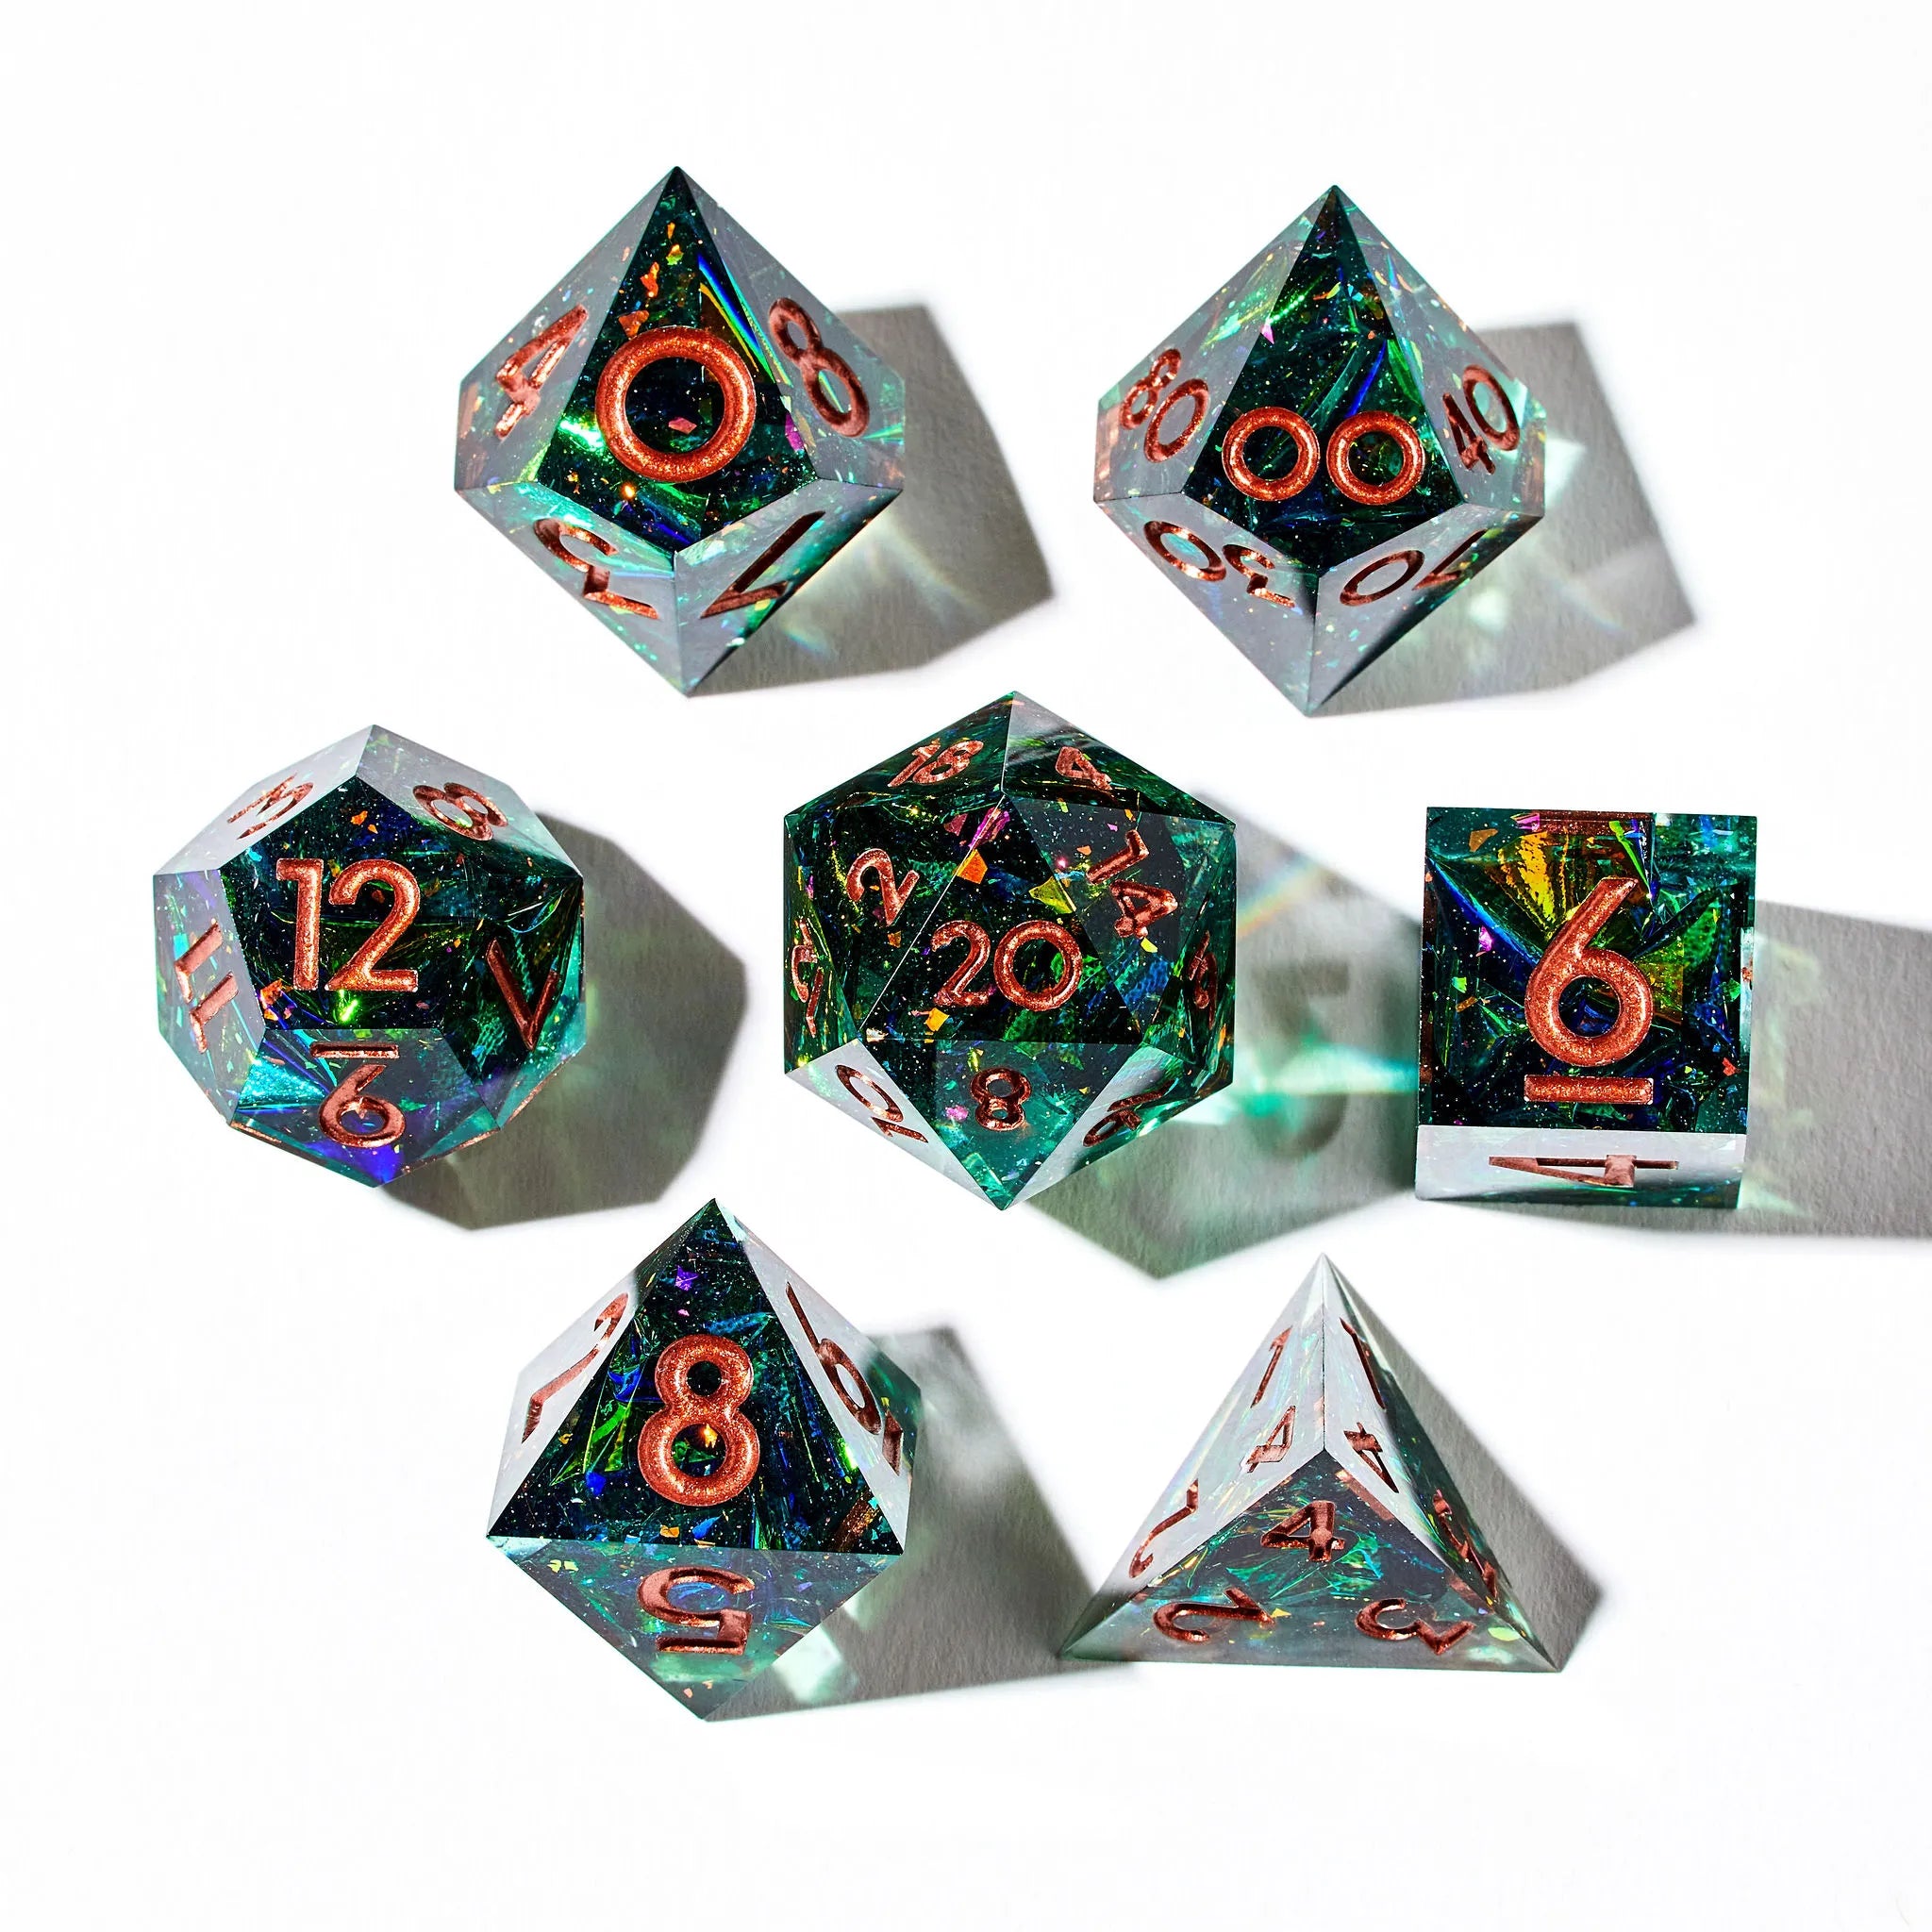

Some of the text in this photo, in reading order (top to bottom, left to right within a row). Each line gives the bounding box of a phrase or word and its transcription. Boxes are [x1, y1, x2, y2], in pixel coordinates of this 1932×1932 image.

[493, 304, 588, 440] 4
[595, 325, 756, 483] 0
[769, 298, 870, 438] 8
[1120, 348, 1209, 463] 80
[1222, 406, 1425, 506] 00
[1442, 364, 1521, 475] 40
[700, 510, 825, 619] 7
[1340, 529, 1488, 607] 70
[888, 739, 984, 788] 18
[1055, 746, 1113, 791] 4
[412, 782, 508, 841] 8
[276, 858, 421, 992] 12
[846, 848, 920, 928] 2
[1086, 829, 1178, 940] 14
[174, 922, 240, 1055] 11
[931, 920, 1083, 1012] 20
[1524, 876, 1653, 1104] 6
[309, 1041, 408, 1148] 6
[836, 1064, 929, 1143] 10
[970, 1066, 1032, 1132] 8
[1489, 1154, 1679, 1188] 4
[522, 1292, 628, 1444] 2
[1250, 1325, 1292, 1408] 1
[637, 1334, 760, 1507] 8
[1246, 1406, 1295, 1474] 4
[1343, 1422, 1400, 1493] 4
[1129, 1479, 1199, 1578] 2
[1260, 1500, 1345, 1563] 4
[636, 1566, 754, 1656] 5
[1152, 1587, 1275, 1643] 2
